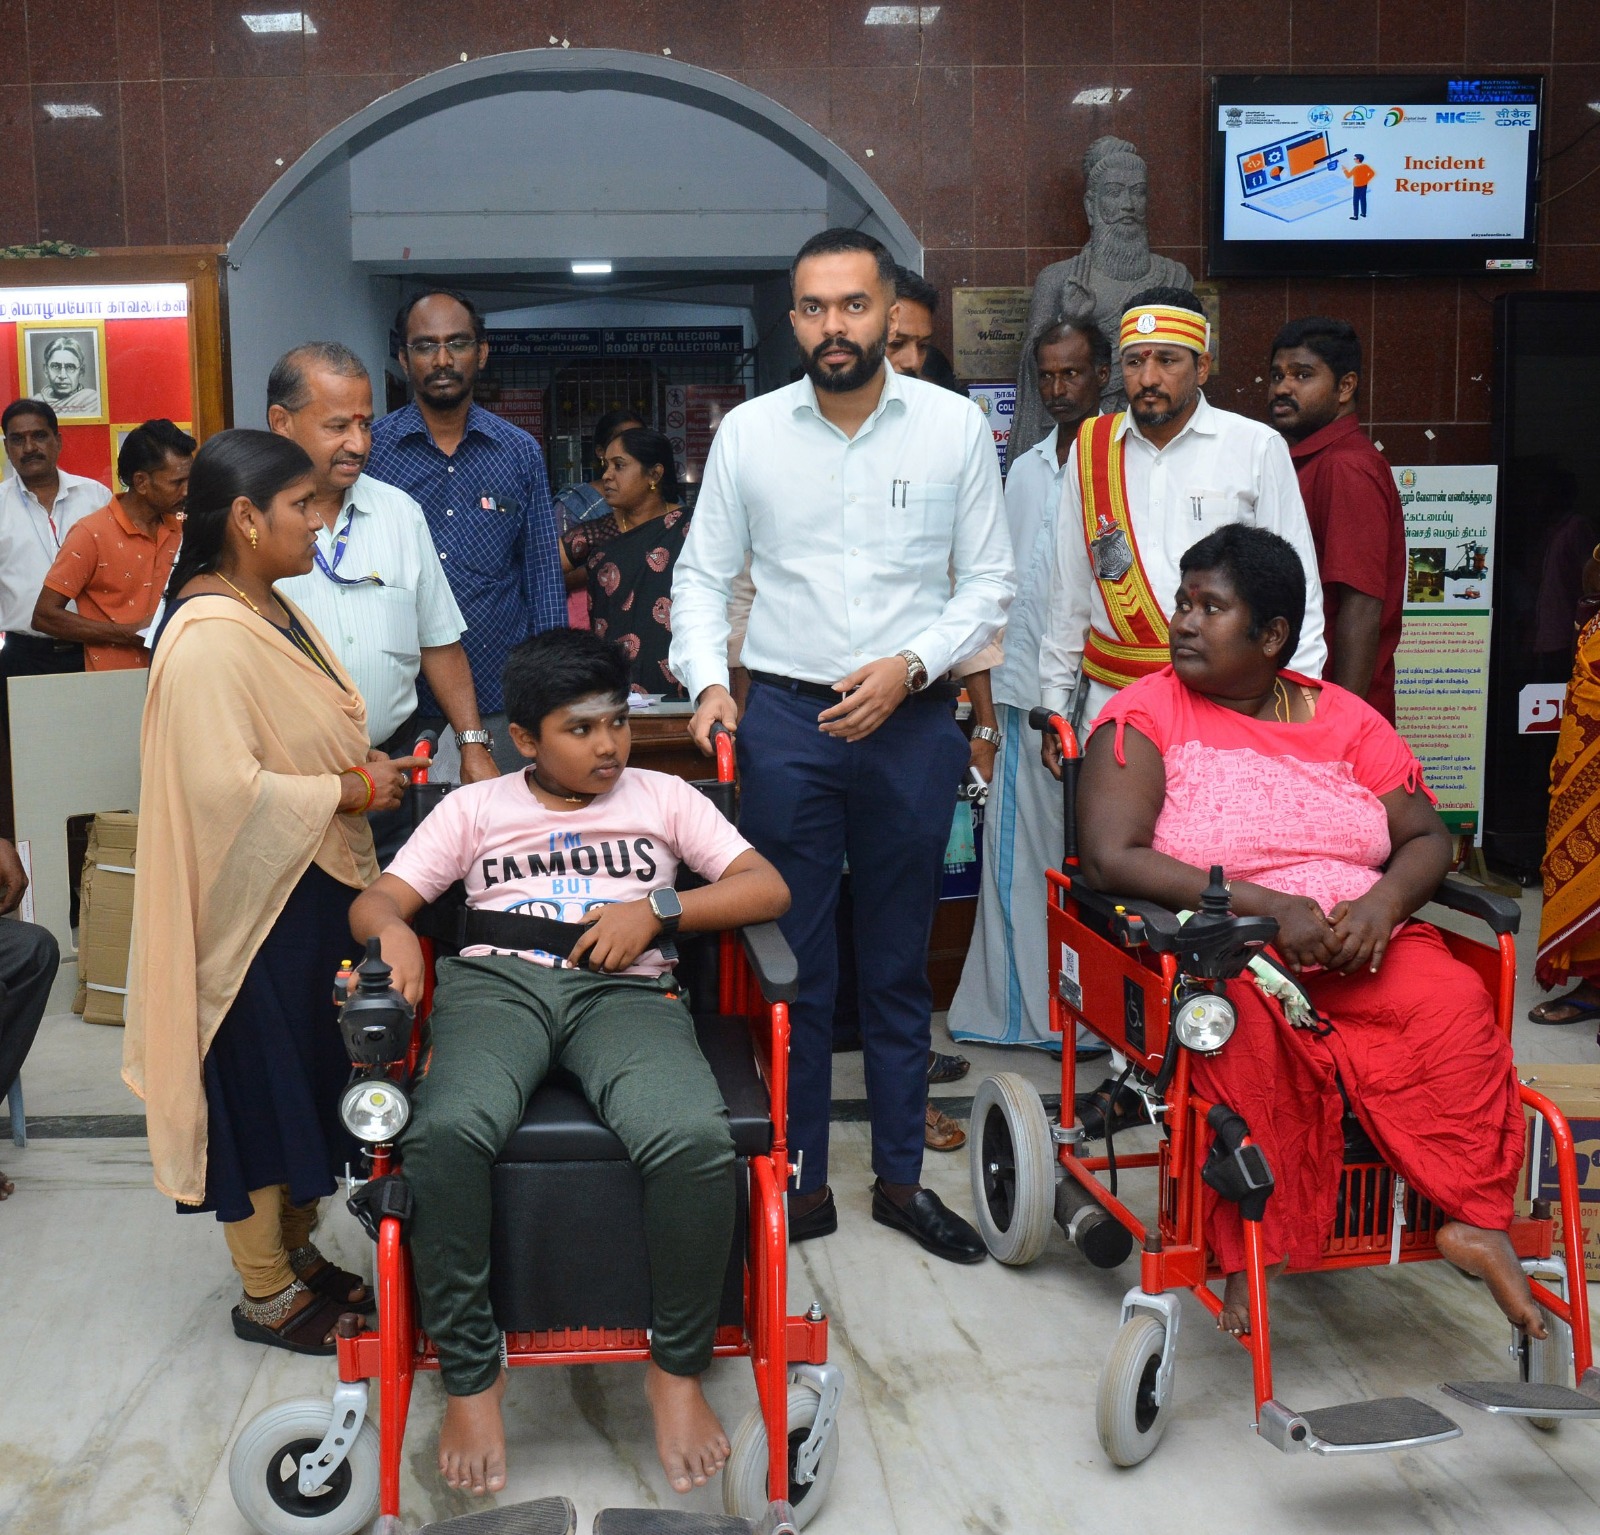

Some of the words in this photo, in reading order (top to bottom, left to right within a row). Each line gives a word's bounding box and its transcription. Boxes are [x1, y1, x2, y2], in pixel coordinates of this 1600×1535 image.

[1448, 80, 1480, 95] NIC
[1435, 111, 1466, 124] NIC
[1495, 119, 1531, 127] CDAC
[1404, 156, 1486, 170] Incident
[1395, 178, 1495, 196] Reporting
[604, 331, 615, 342] 04
[626, 331, 673, 342] CENTRAL
[677, 331, 720, 341] RECORD
[977, 330, 1015, 341] William
[606, 343, 638, 353] ROOM
[642, 343, 656, 353] OF
[659, 342, 740, 353] COLLECTORATE
[1461, 526, 1487, 539] திட்டம்
[549, 831, 582, 851] I'M
[482, 837, 657, 890] FAMOUS
[552, 878, 593, 895] BUT
